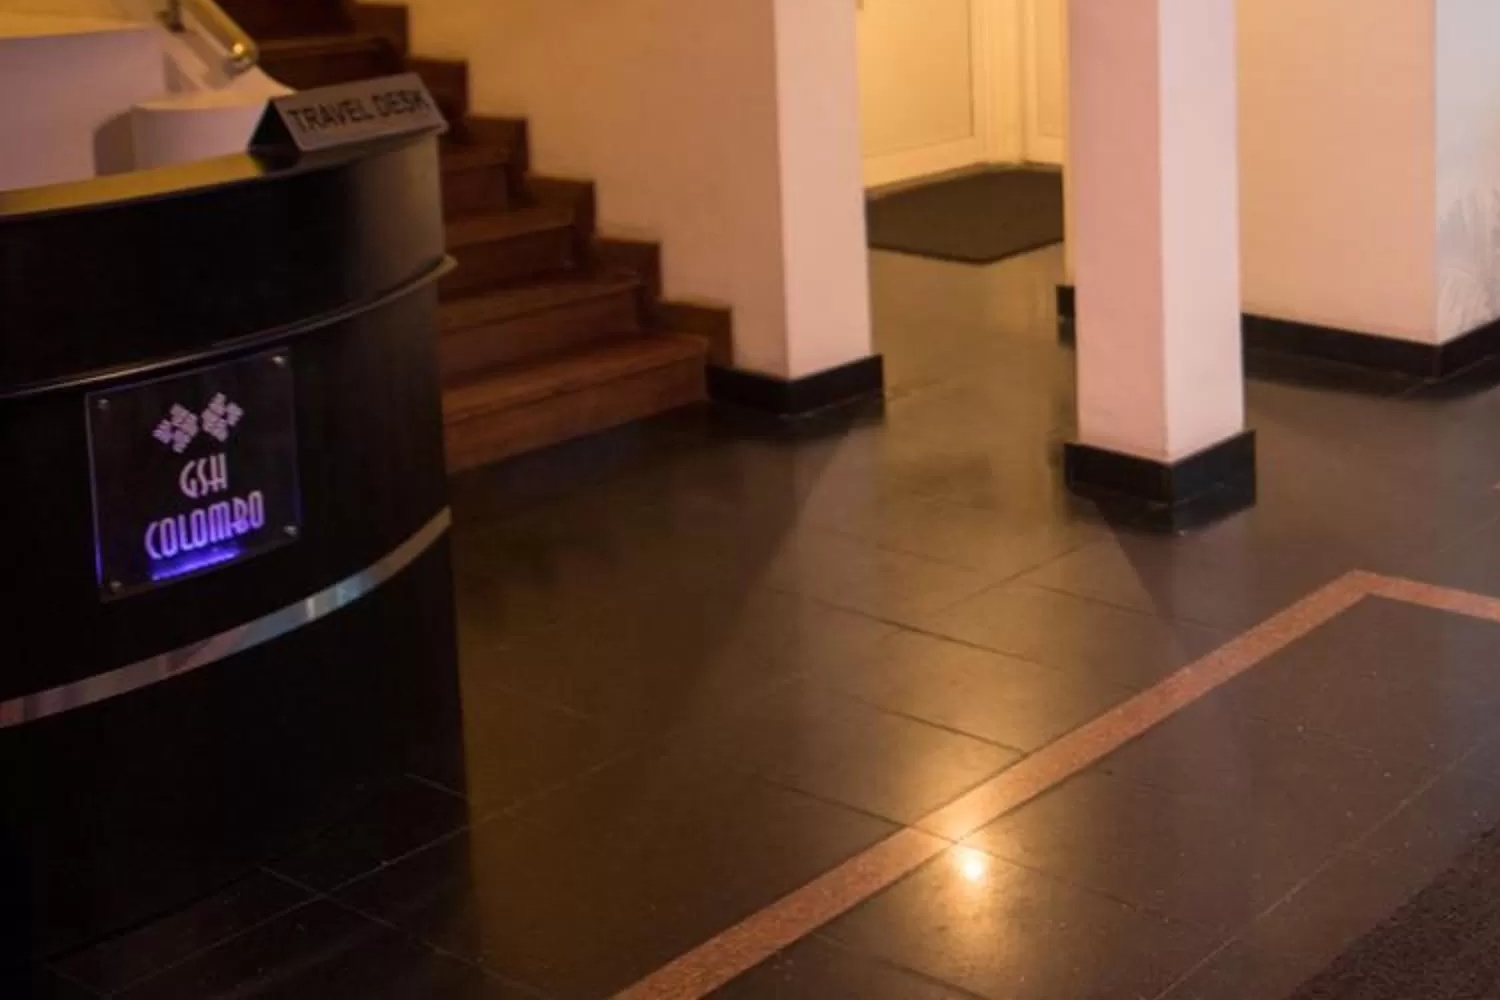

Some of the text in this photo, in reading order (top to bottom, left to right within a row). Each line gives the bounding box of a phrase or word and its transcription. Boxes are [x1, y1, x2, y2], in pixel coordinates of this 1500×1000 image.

[286, 90, 430, 134] TRAVEL DESK
[179, 453, 228, 499] GSH
[144, 490, 265, 559] COLOMBO
